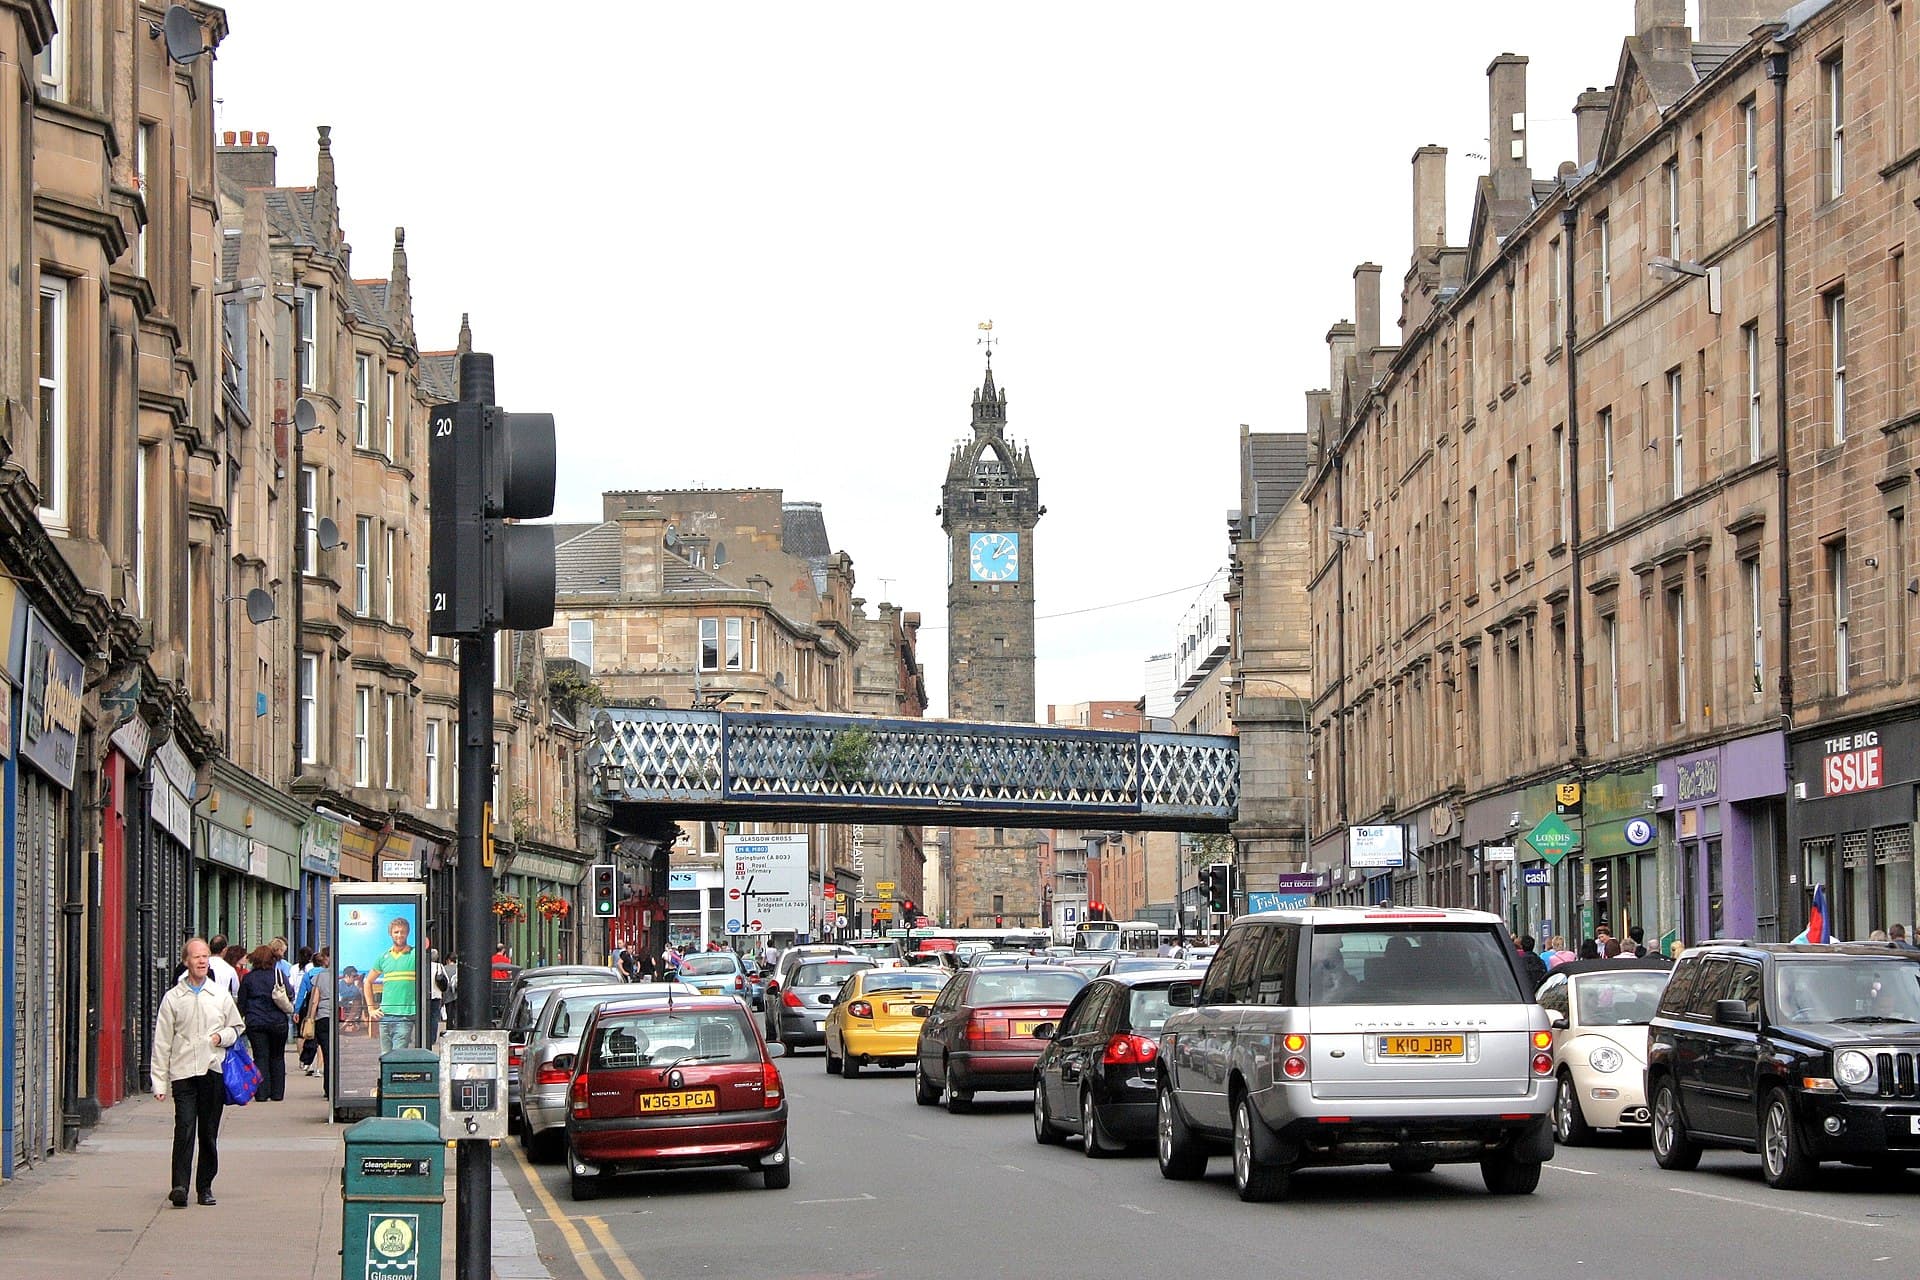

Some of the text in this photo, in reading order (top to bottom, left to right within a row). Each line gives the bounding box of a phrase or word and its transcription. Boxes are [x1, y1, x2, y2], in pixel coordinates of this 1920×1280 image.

[435, 418, 452, 437] 20
[434, 592, 446, 611] 21
[1825, 731, 1878, 754] THE BIG
[1826, 749, 1879, 794] ISSUE
[1535, 834, 1571, 842] LONDIS
[1256, 894, 1279, 910] Fish
[1396, 1038, 1452, 1053] K10 JBR
[643, 1092, 713, 1109] W363 PGA
[371, 1271, 413, 1280] Glasgow
